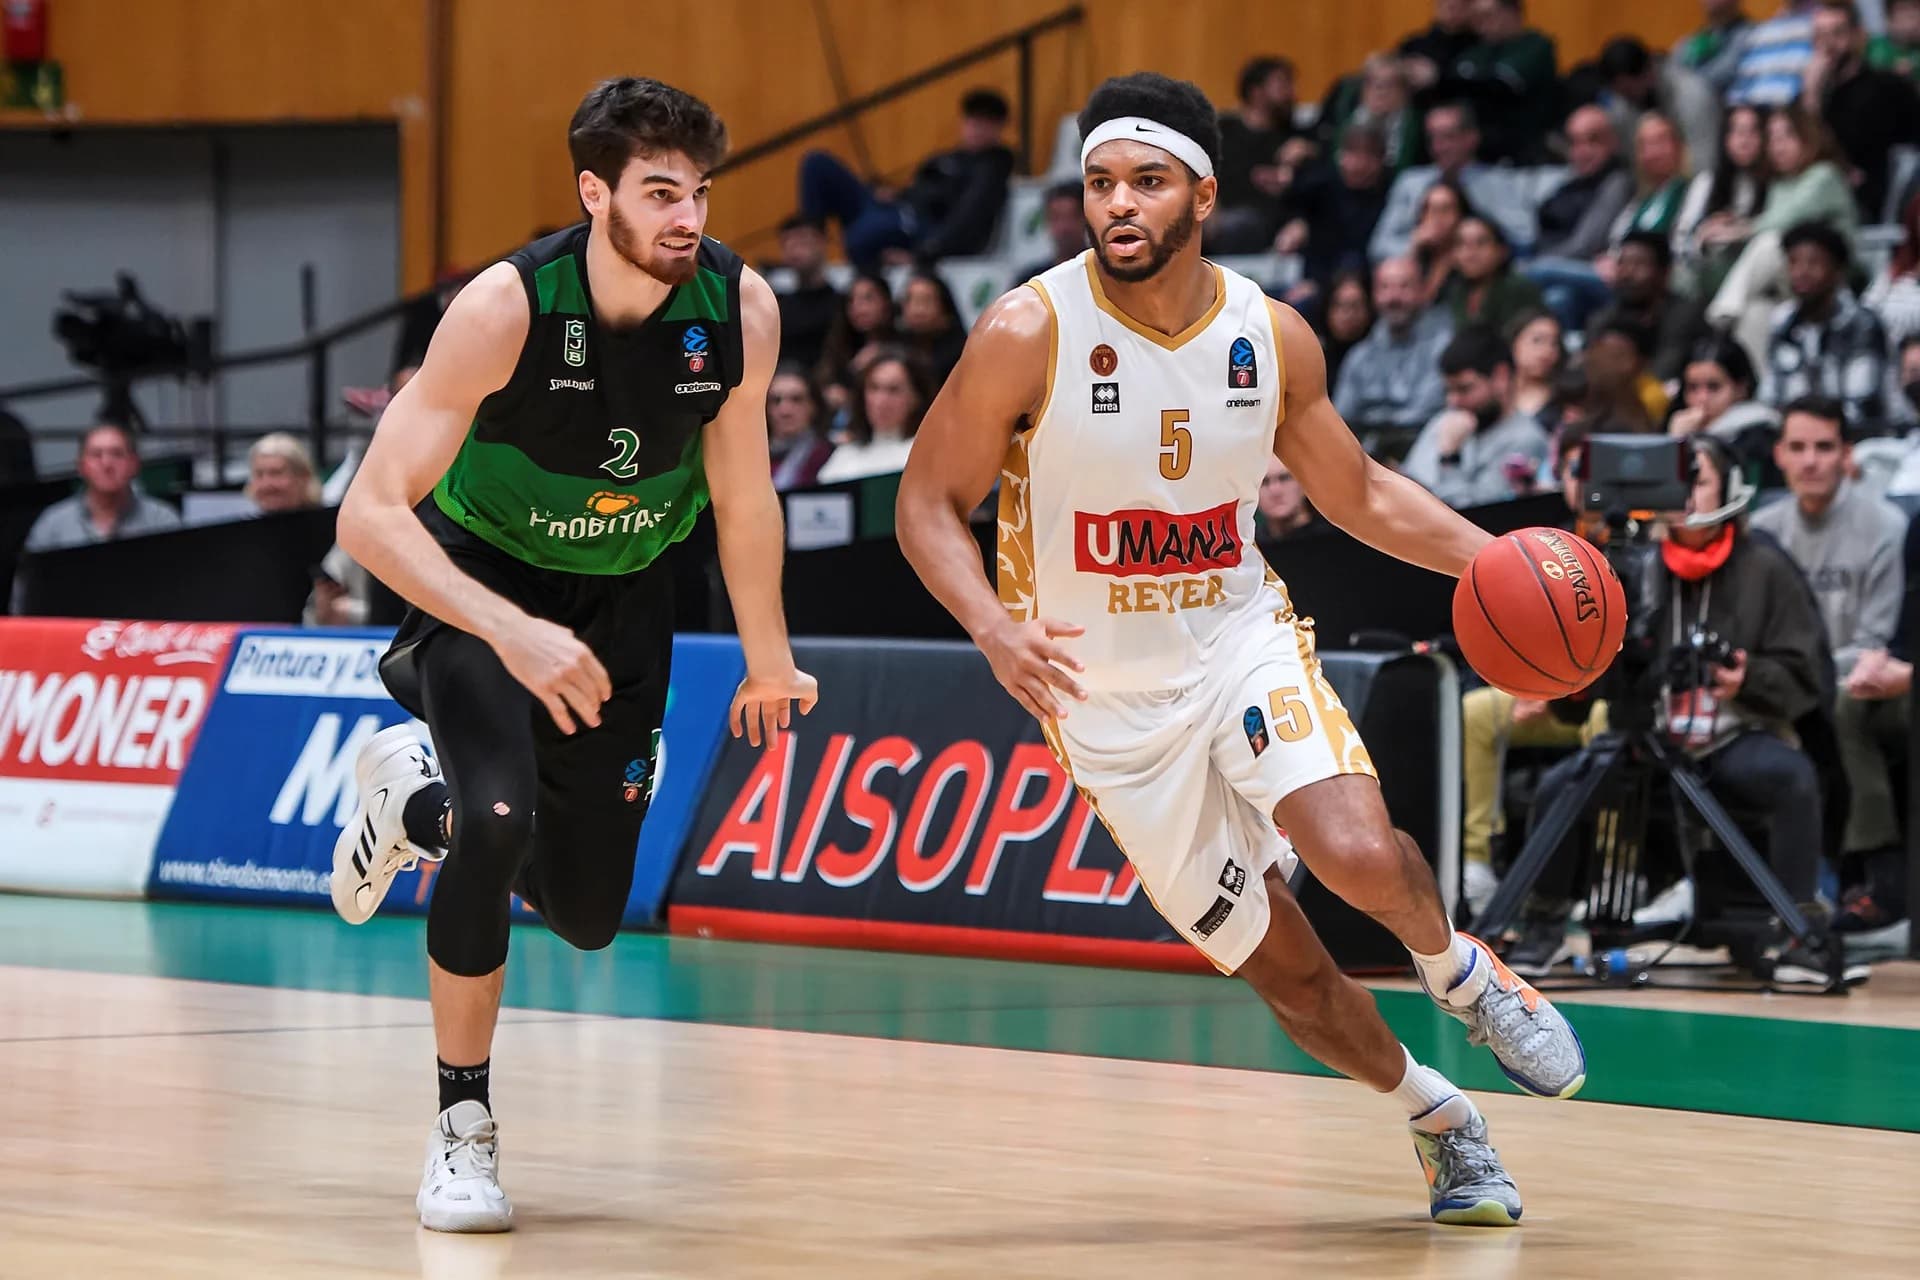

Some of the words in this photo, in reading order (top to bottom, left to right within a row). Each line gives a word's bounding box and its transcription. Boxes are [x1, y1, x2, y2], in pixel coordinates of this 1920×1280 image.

[549, 379, 595, 391] SPALDING
[675, 382, 721, 394] oneteam
[1226, 398, 1261, 407] oneteam
[598, 427, 640, 478] 2
[1159, 409, 1192, 480] 5
[1087, 514, 1236, 567] UMANA
[1107, 575, 1227, 614] REYER
[236, 643, 328, 680] Pintura
[1268, 686, 1313, 743] 5
[697, 731, 1141, 905] AISOPL
